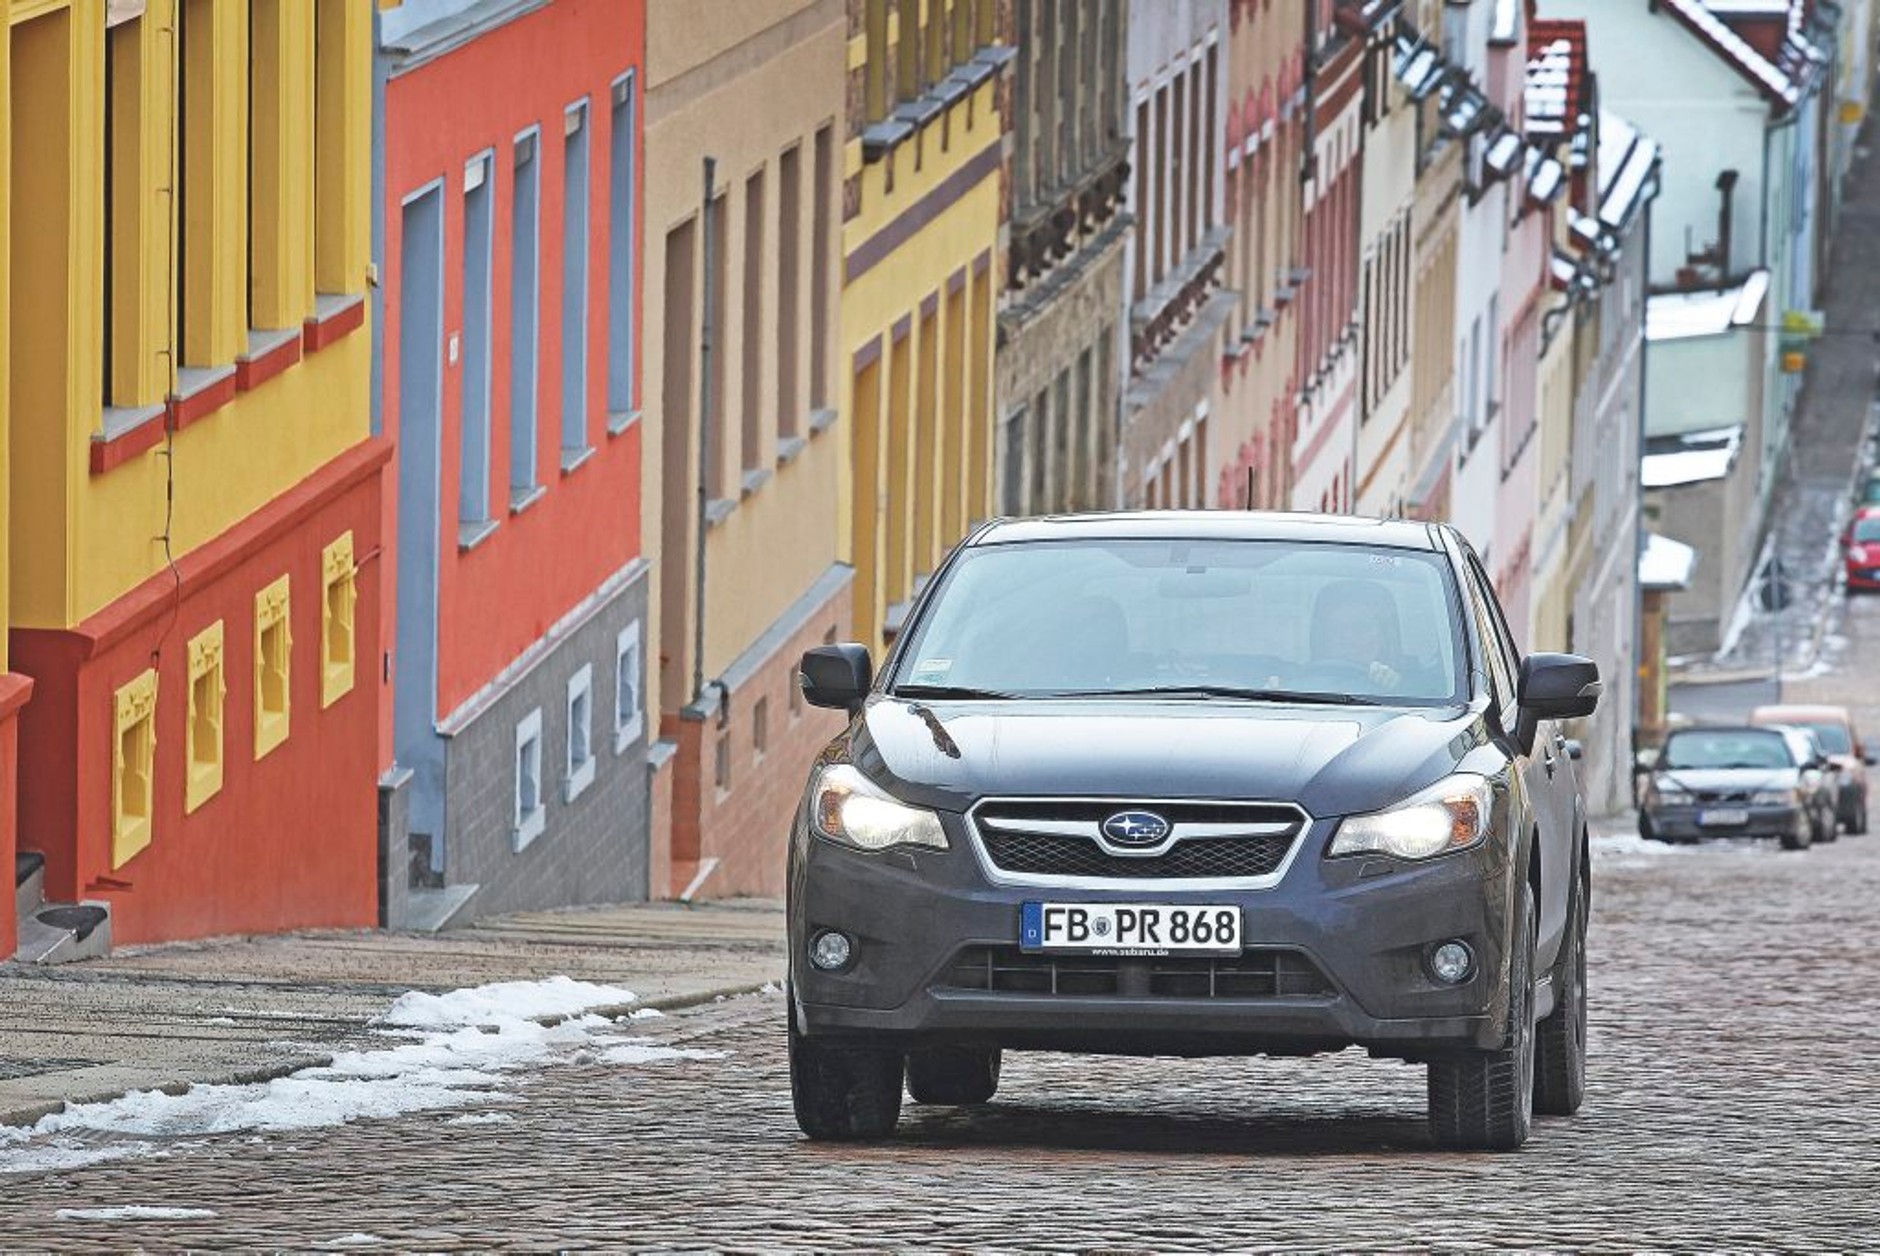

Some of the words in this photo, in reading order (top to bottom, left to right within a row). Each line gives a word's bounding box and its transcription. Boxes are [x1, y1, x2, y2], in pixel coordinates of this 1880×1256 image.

[1044, 908, 1090, 941] FB
[1115, 909, 1161, 943] PR
[1169, 910, 1235, 944] 868
[1028, 929, 1037, 938] D
[1092, 947, 1169, 956] www.subaru.de
